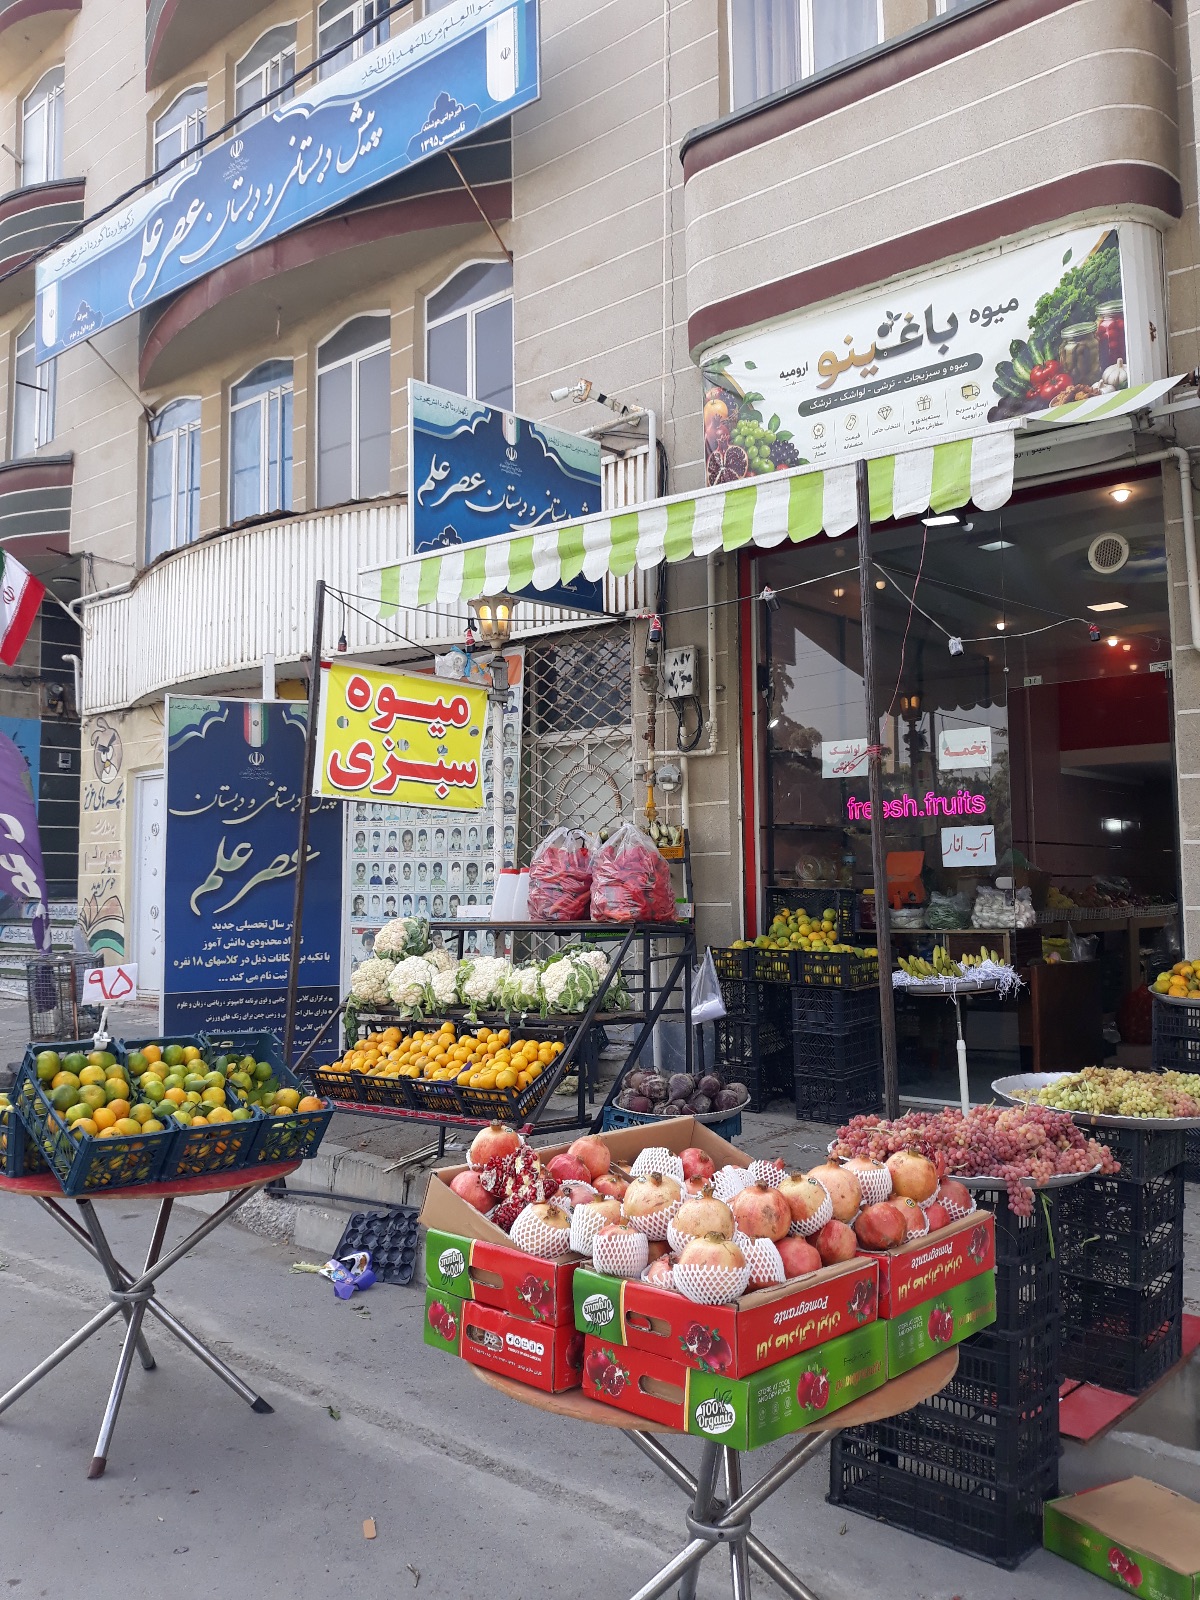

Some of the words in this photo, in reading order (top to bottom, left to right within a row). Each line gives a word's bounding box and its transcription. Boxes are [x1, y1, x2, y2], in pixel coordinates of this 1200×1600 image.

[336, 101, 383, 173] پیش
[439, 121, 465, 145] تاسیس
[236, 136, 331, 250] دبستانی
[264, 184, 273, 206] و
[180, 176, 260, 264] دبستان
[142, 198, 204, 302] عصر
[128, 218, 164, 310] علم
[969, 297, 1020, 327] میوه
[779, 361, 809, 381] ارومیه
[942, 367, 948, 375] و
[949, 361, 969, 373] میوه
[903, 369, 941, 384] سبزیجات
[873, 379, 896, 394] ترشی
[839, 387, 866, 402] لواشک
[809, 398, 832, 411] ترشک
[416, 453, 451, 507] علم
[429, 471, 486, 508] عصر
[465, 486, 528, 517] دبستان
[530, 506, 536, 517] و
[345, 674, 471, 738] میوه
[829, 744, 861, 757] لواشک
[943, 740, 987, 757] تخمه
[326, 737, 479, 799] سبزی
[168, 785, 245, 816] دبستان
[222, 781, 302, 825] دبستانی
[248, 798, 256, 809] و
[942, 833, 963, 856] انار
[966, 829, 994, 857] آب
[190, 835, 254, 916] علم
[213, 844, 321, 914] عصر
[212, 921, 235, 932] جدید
[236, 919, 268, 932] تحصیلی
[268, 919, 284, 930] سال
[202, 937, 223, 950] آموز
[223, 937, 245, 950] دانش
[246, 938, 281, 949] محدودی
[173, 957, 191, 969] نفره
[192, 955, 203, 966] ۱۸
[204, 955, 239, 968] کلاسهای
[240, 957, 250, 967] در
[251, 953, 267, 965] ذیل
[268, 953, 291, 963] کانات
[298, 955, 307, 965] بر
[307, 953, 323, 962] تکیه
[323, 952, 331, 962] با
[229, 971, 245, 982] کند
[245, 975, 259, 984] می
[260, 970, 272, 981] نام
[272, 969, 288, 980] ثبت
[88, 967, 134, 1000] ۹۵
[440, 1251, 465, 1266] Organic
[898, 1277, 912, 1301] انار
[913, 1263, 944, 1291] صادراتی
[944, 1255, 963, 1278] ایران
[584, 1296, 613, 1313] Organic
[590, 1309, 611, 1325] 100%
[756, 1334, 774, 1361] انار
[775, 1319, 815, 1350] صادراتی
[816, 1311, 841, 1338] ایران
[701, 1400, 726, 1416] 100%
[697, 1412, 733, 1430] Organic
